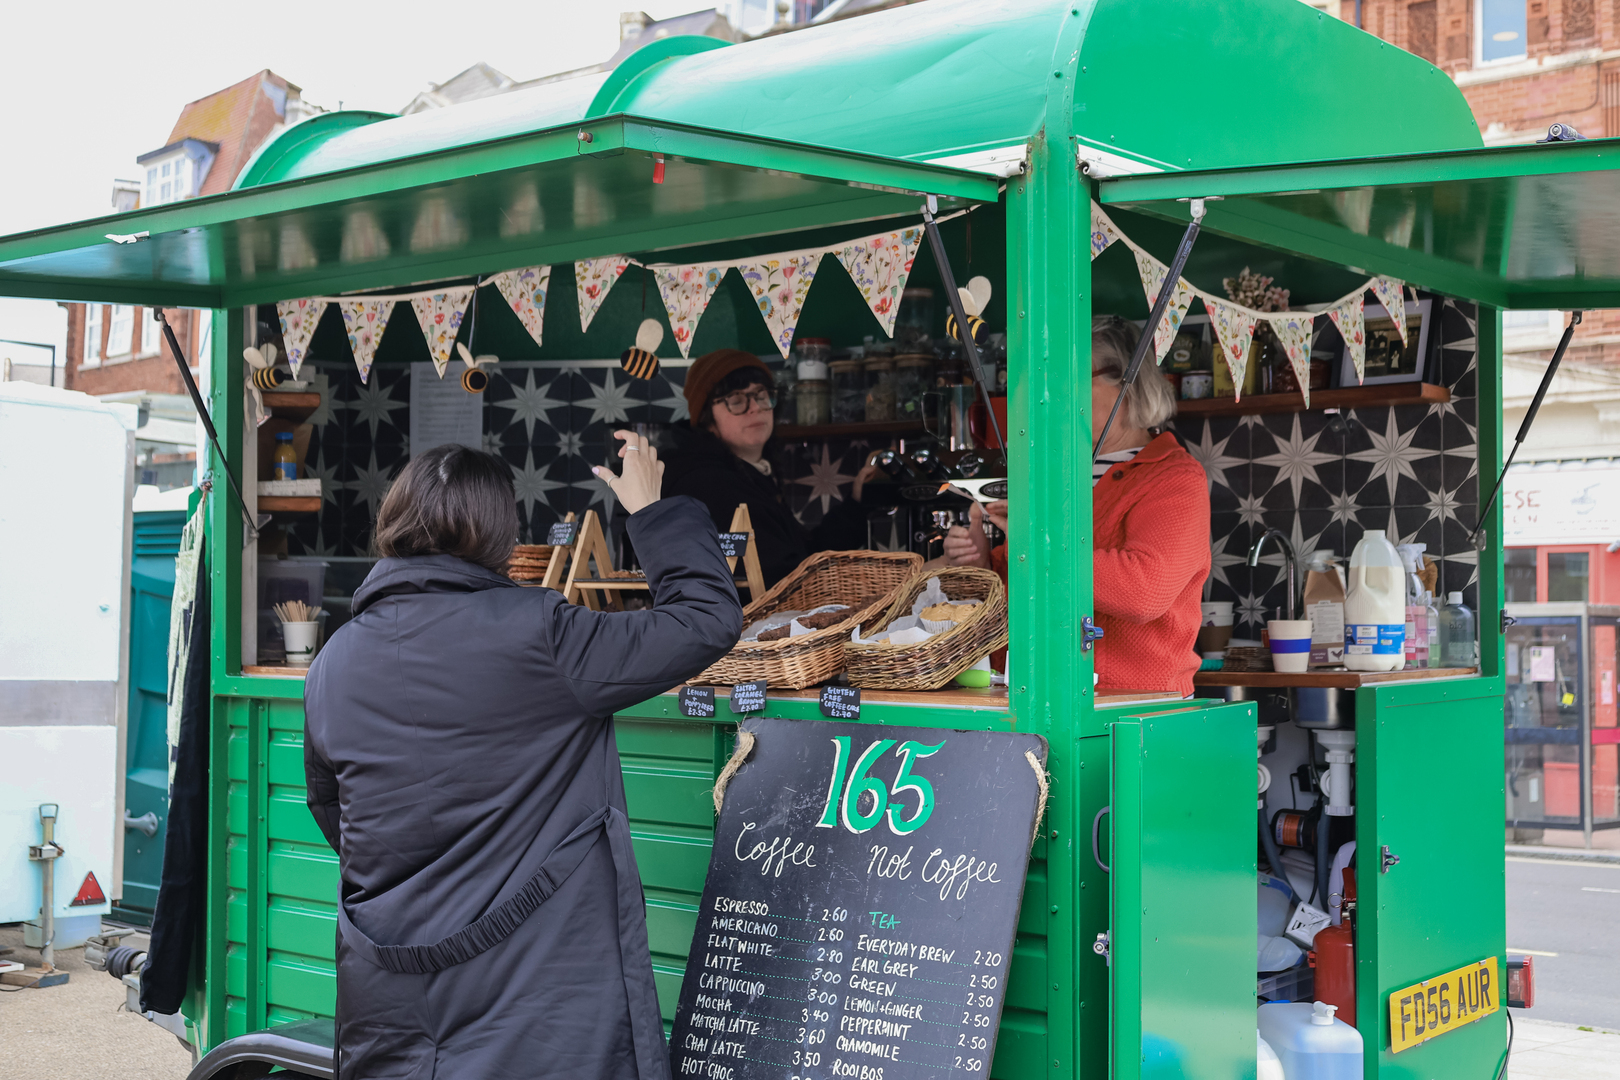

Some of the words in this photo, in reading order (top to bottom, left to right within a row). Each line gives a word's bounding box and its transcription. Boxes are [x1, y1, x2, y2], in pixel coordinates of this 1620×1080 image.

[686, 688, 709, 697] LEMON
[823, 693, 842, 702] FREE
[827, 686, 855, 697] GLUTEN
[815, 735, 947, 836] 165
[735, 821, 817, 878] Coffee
[921, 848, 1001, 901] Coffee
[714, 896, 769, 916] ESPRESSO
[711, 916, 778, 937] AMERICANO
[869, 911, 901, 930] TEA
[707, 934, 738, 950] FLAT
[738, 940, 773, 957] WHITE
[857, 934, 917, 958] EVERYDAY
[918, 944, 955, 964] BREW
[704, 952, 743, 972] LATTE
[851, 956, 880, 974] EARL
[883, 959, 919, 979] GREY
[699, 972, 765, 996] CAPPUCCINO
[849, 974, 897, 997] GREEN
[695, 993, 733, 1012] MOCHA
[1400, 981, 1450, 1042] FD56
[1457, 967, 1492, 1019] AUR
[690, 1013, 726, 1034] MATCHA
[727, 1018, 761, 1035] LATTE
[840, 1014, 912, 1041] PEPPERMINT
[685, 1033, 708, 1052] CHAI
[711, 1040, 747, 1059] LATTE
[835, 1035, 900, 1062] CHAMOMILE
[681, 1056, 706, 1075] HOT
[707, 1063, 735, 1080] CHOC
